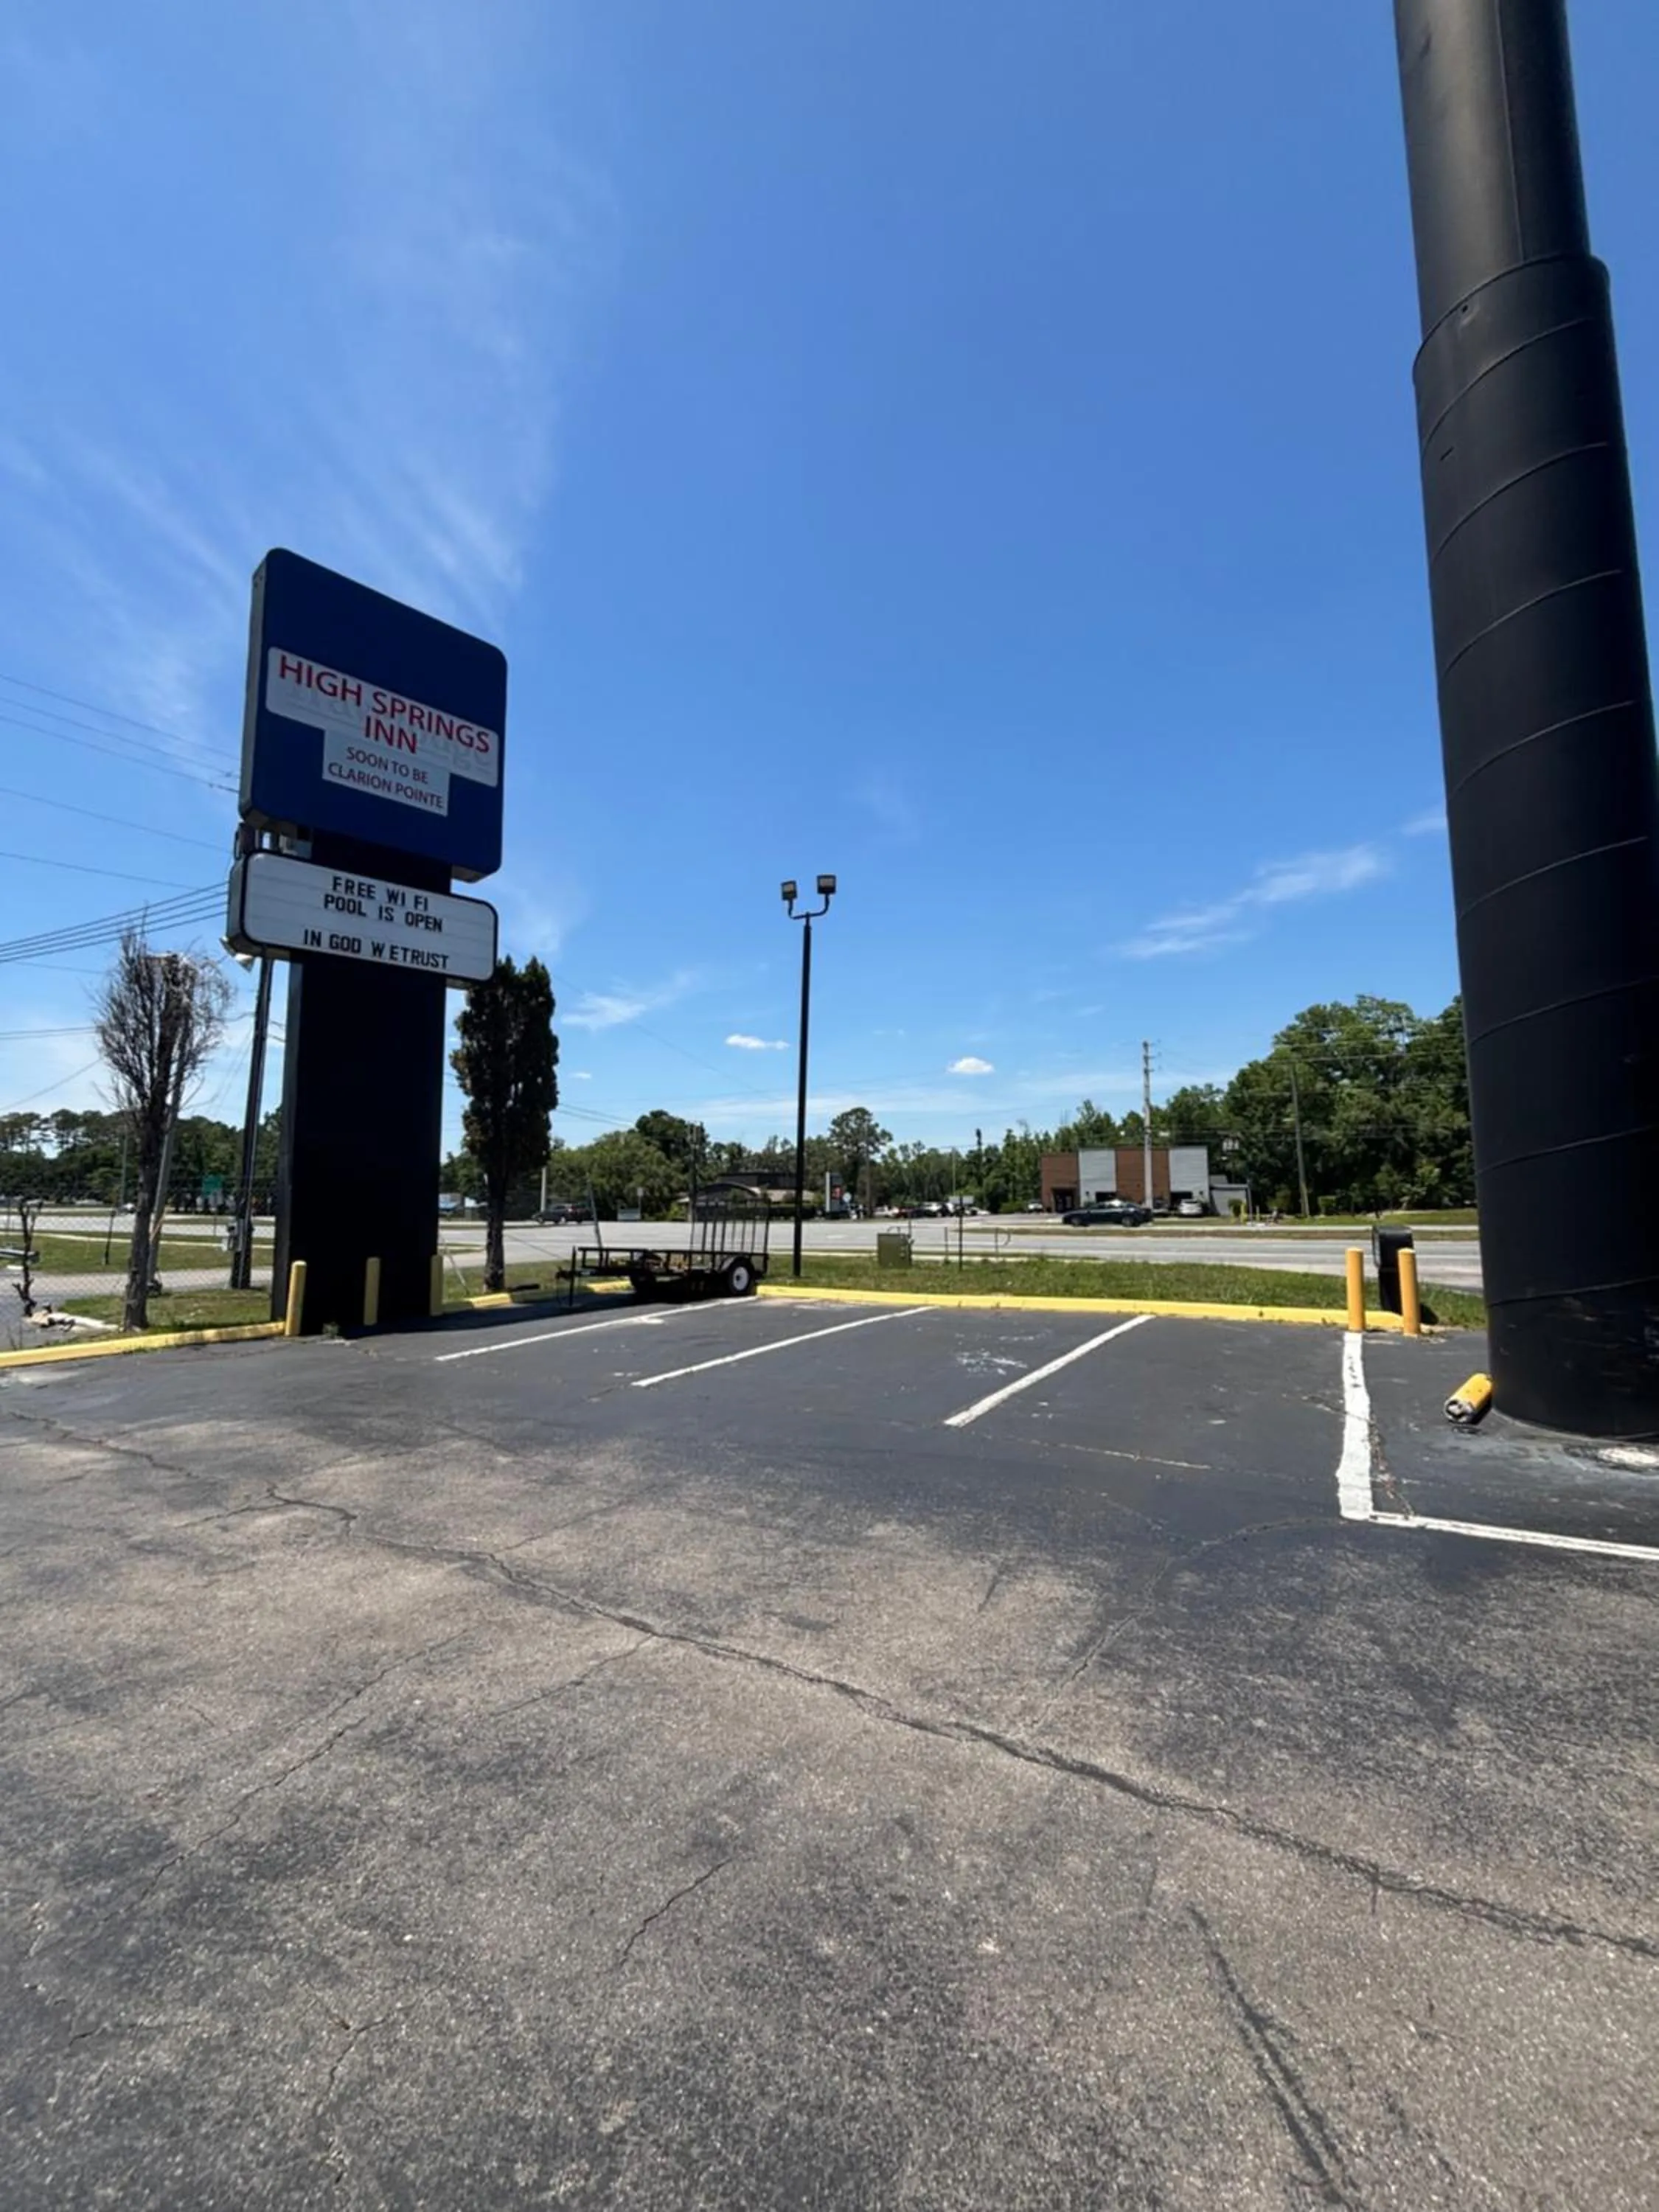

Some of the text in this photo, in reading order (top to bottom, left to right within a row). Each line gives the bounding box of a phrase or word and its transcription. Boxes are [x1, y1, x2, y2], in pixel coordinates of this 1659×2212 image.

[279, 655, 361, 706] HIGH
[372, 691, 490, 753] SPRINGS
[364, 715, 417, 754] INN
[328, 762, 444, 808] CLARION POINTE
[347, 746, 428, 785] SOON TO BE
[324, 894, 442, 933] POOL IS OPEN
[333, 876, 428, 912] FREE WI FI
[303, 929, 321, 947] IN
[329, 933, 361, 953] GOD
